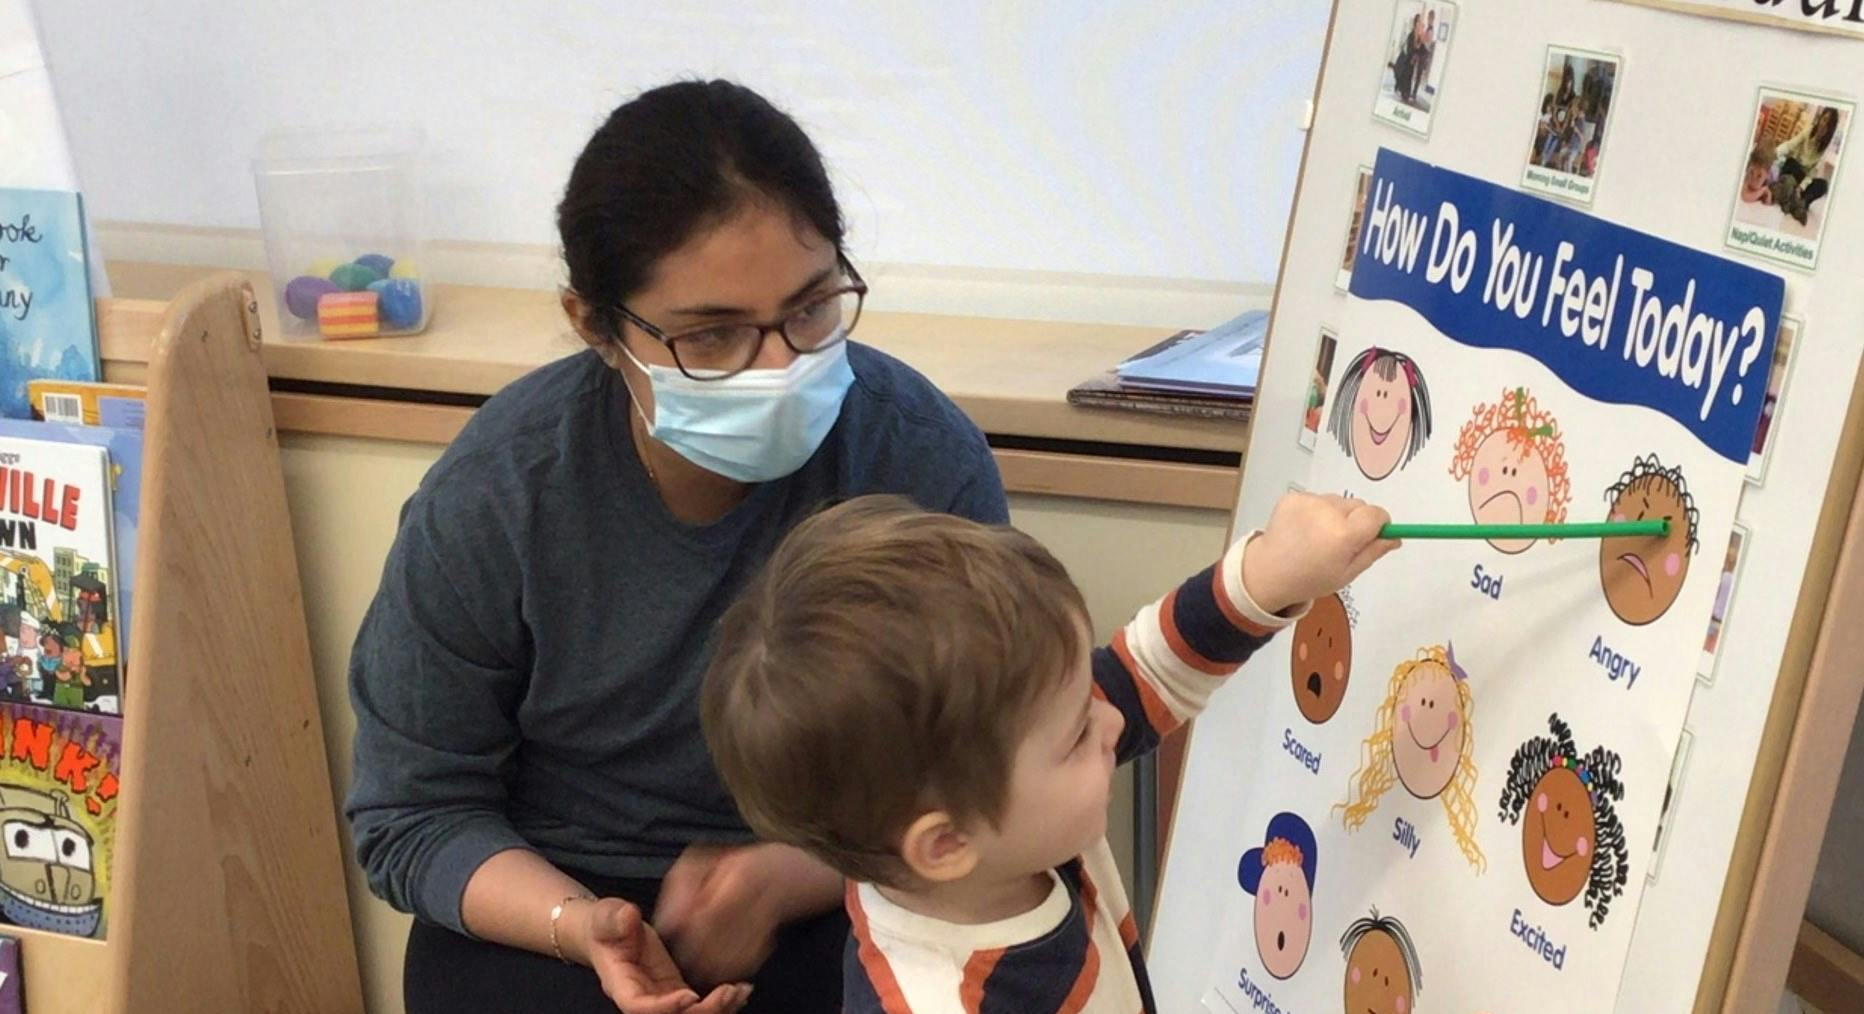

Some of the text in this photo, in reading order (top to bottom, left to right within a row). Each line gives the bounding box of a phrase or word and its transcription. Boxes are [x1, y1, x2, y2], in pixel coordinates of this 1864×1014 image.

[1363, 177, 1766, 421] How Do You Feel Today?
[1471, 563, 1504, 600] Sad
[1589, 635, 1641, 691] Angry
[0, 708, 119, 816] NK!
[1282, 727, 1323, 776] Scared
[1392, 816, 1422, 860] Silly
[1510, 908, 1567, 971] Excited
